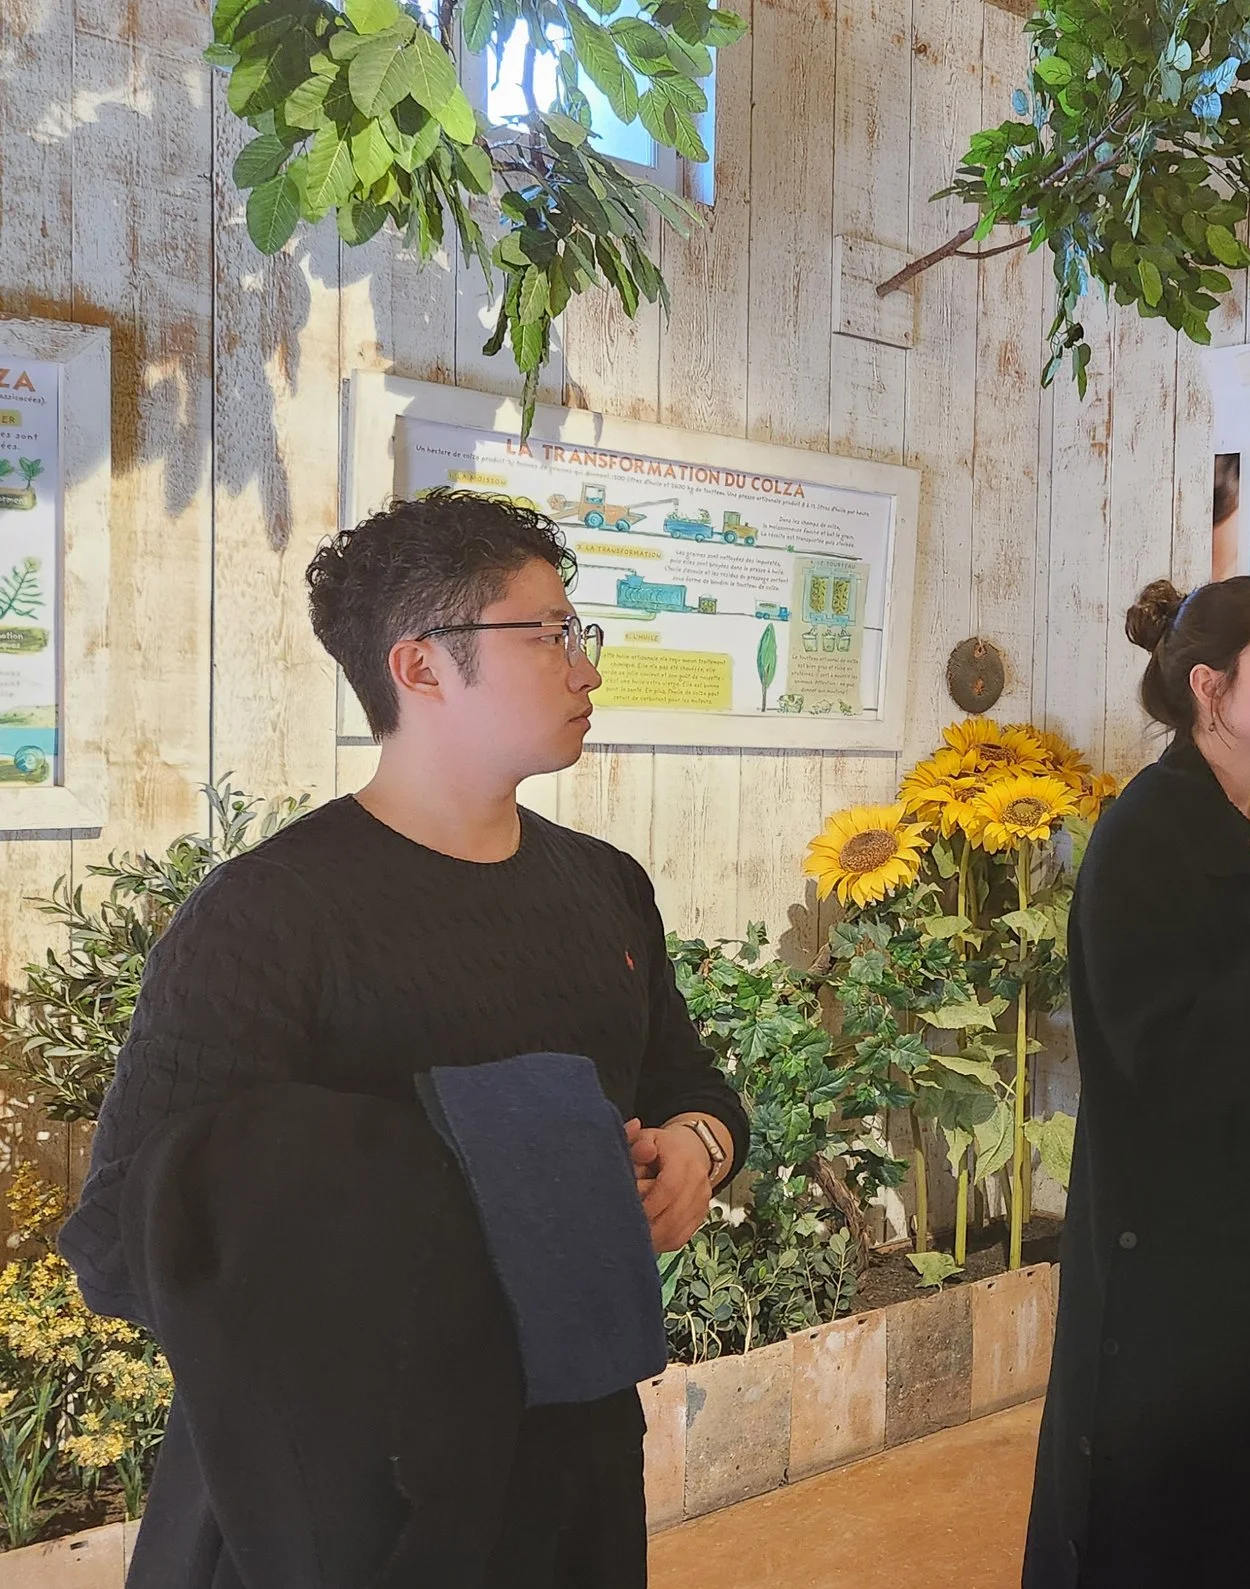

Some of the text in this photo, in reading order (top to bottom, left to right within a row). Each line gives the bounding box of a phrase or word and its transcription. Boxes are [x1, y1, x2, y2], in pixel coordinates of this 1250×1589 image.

[0, 368, 36, 392] ZA
[1, 415, 16, 424] ER
[506, 438, 805, 498] LA TRANSFORMATION DU COLZA
[469, 475, 507, 486] MOISSON
[598, 546, 662, 559] TRANSFORMATION
